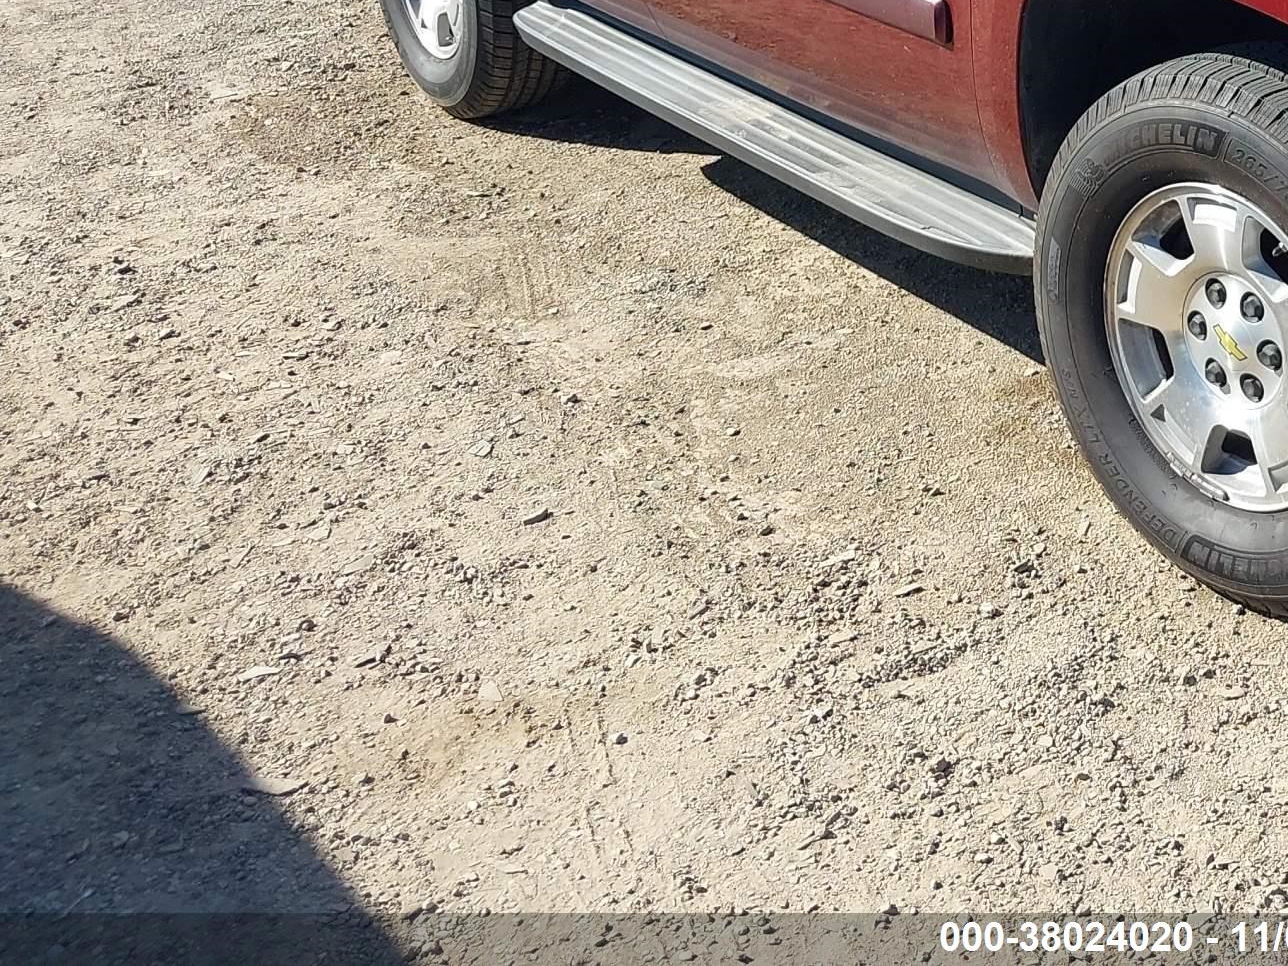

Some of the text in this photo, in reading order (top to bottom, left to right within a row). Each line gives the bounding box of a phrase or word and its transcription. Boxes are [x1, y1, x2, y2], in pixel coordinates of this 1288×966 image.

[1103, 122, 1219, 167] MICHELIN
[1076, 406, 1102, 444] LTX
[1096, 451, 1179, 543] DEFENDER
